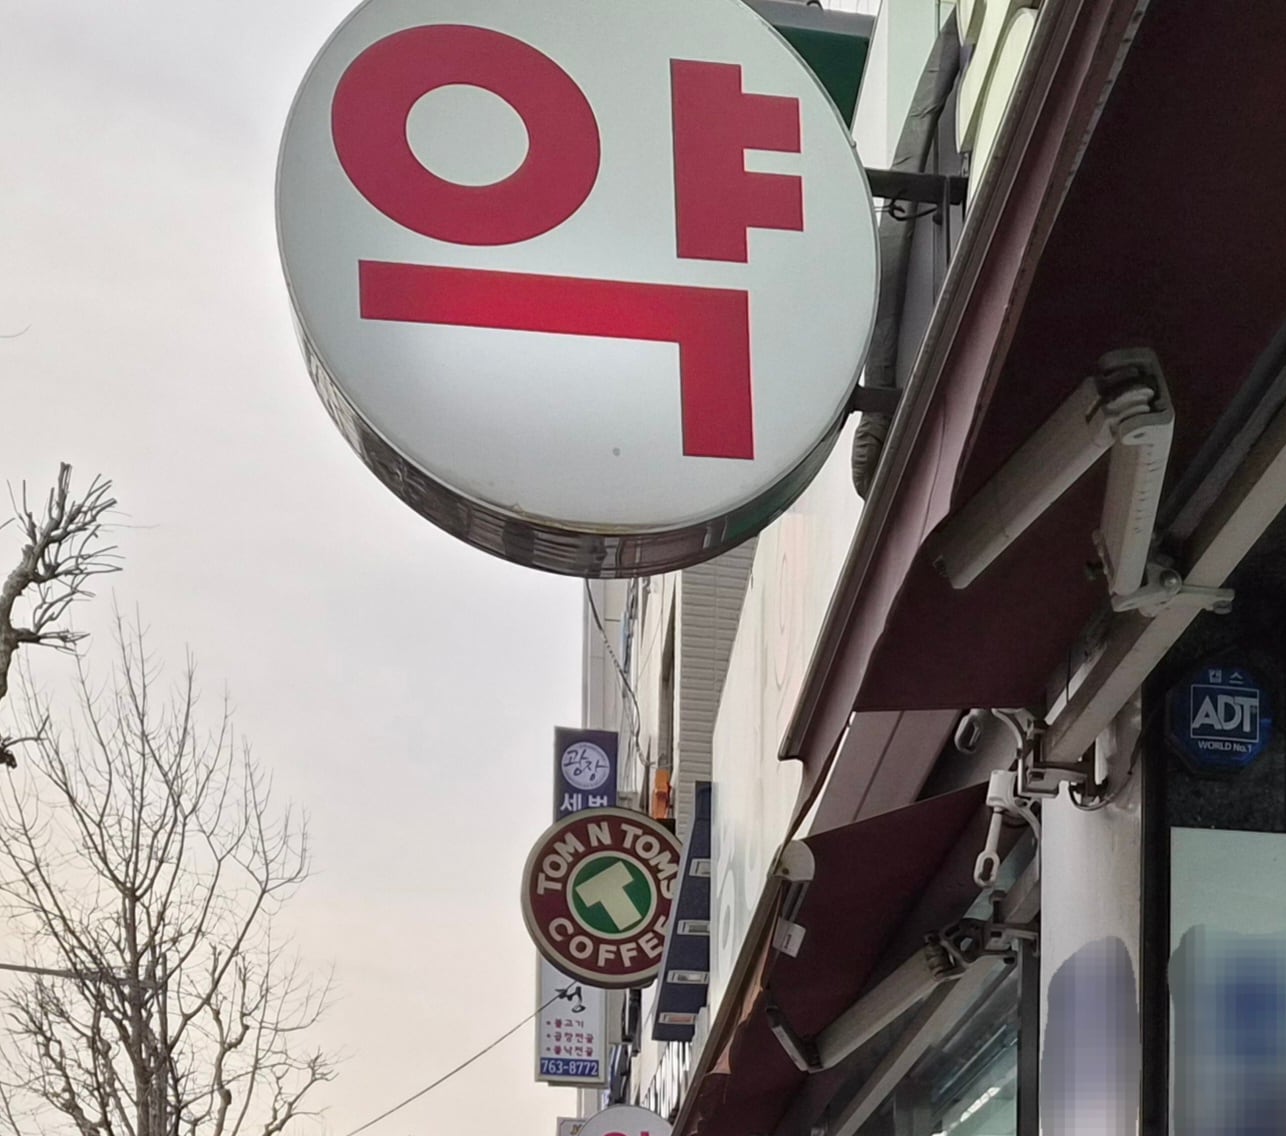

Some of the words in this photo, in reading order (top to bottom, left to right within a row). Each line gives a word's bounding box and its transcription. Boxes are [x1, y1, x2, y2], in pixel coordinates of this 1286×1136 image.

[331, 23, 804, 459] 약
[1191, 695, 1259, 733] ADT
[1197, 740, 1232, 751] WORLD
[536, 830, 586, 895] TOM
[587, 820, 612, 848] N
[541, 1060, 598, 1076] 763-8772
